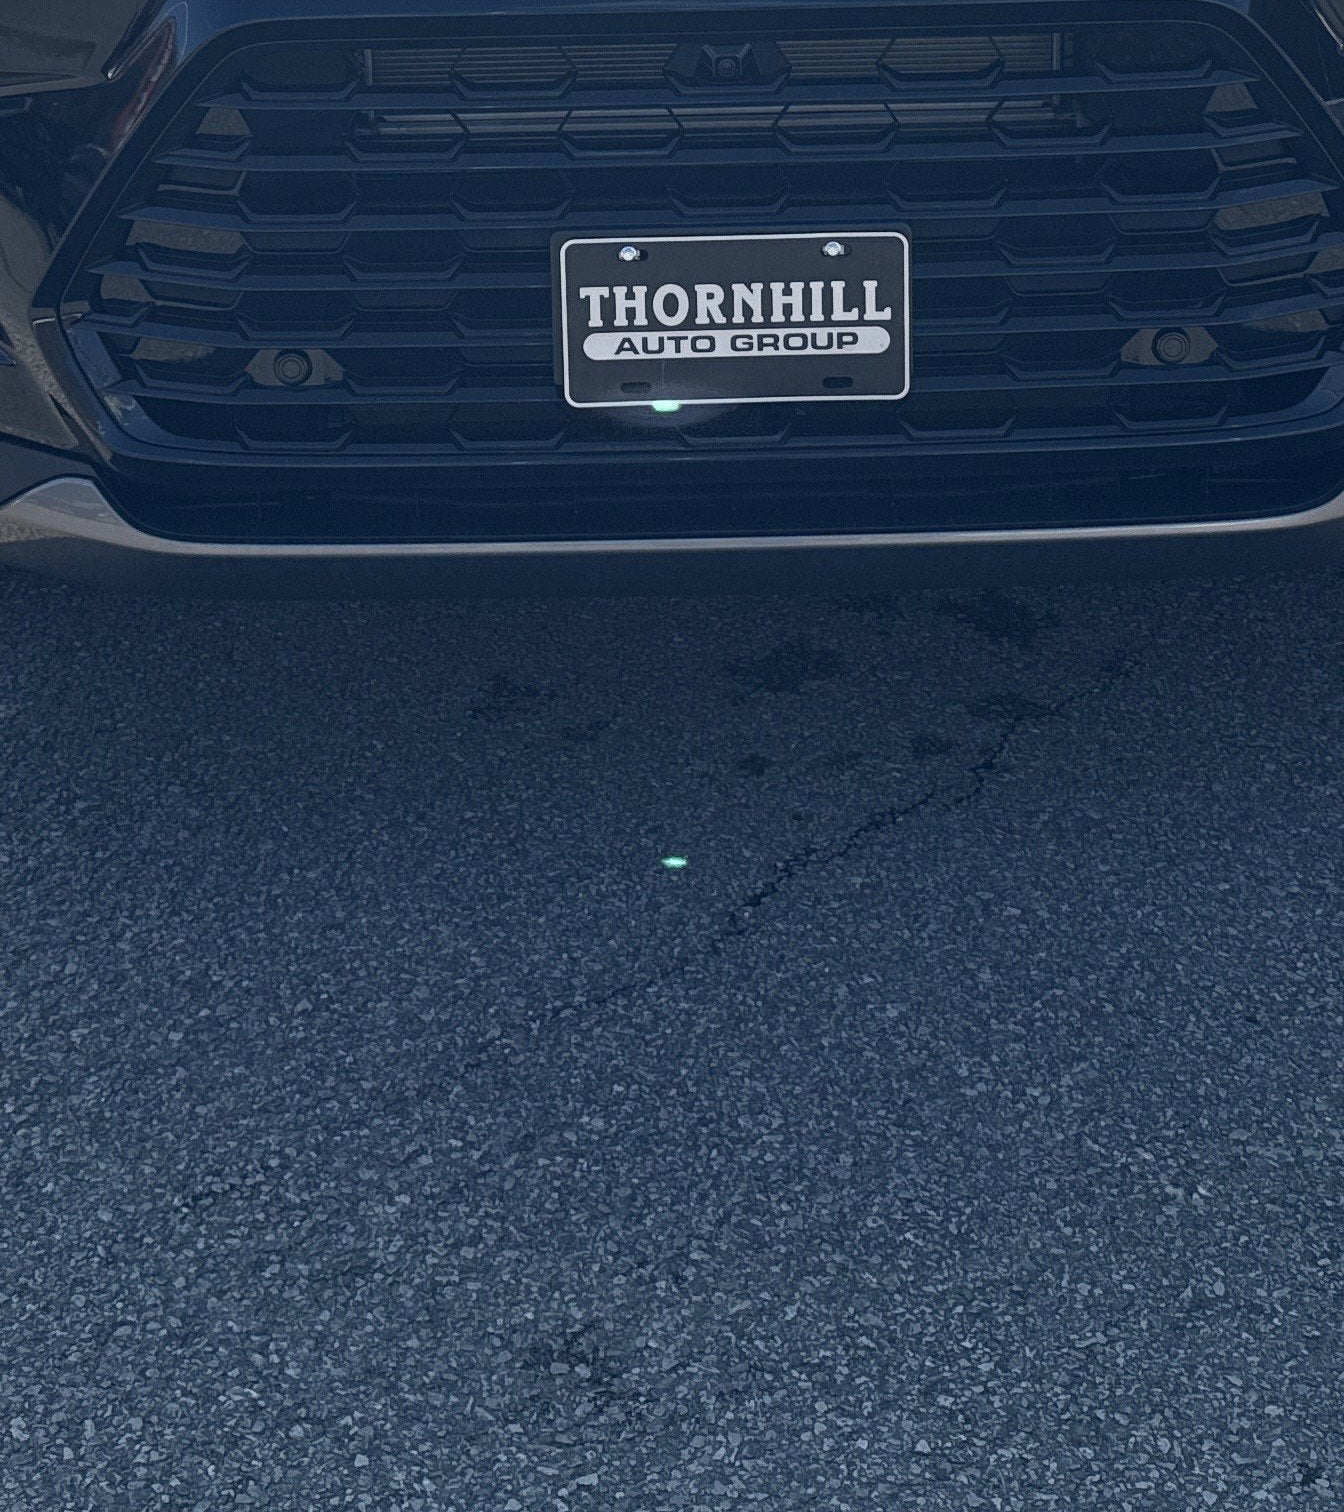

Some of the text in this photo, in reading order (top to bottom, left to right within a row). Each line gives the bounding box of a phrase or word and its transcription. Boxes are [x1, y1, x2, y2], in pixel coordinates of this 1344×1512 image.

[578, 279, 892, 328] THORNHILL
[614, 331, 859, 356] AUTO GROUP
